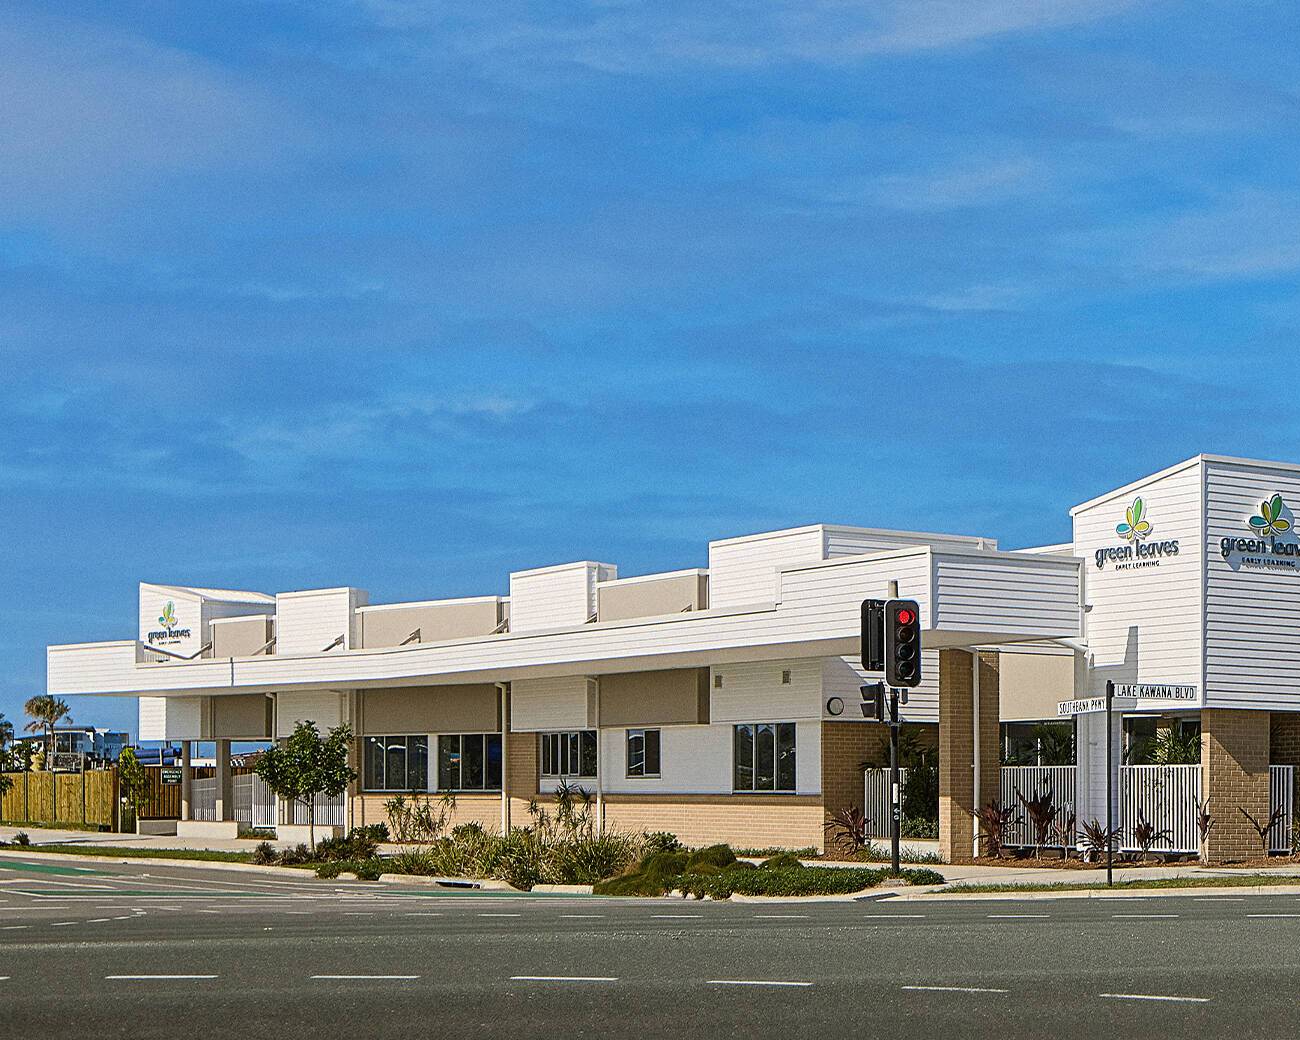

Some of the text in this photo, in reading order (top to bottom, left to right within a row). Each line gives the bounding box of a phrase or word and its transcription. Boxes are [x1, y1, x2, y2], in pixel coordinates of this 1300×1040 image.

[1095, 538, 1179, 569] green leaves
[1220, 537, 1266, 558] green
[1115, 560, 1160, 571] EARLY LEARNING
[1263, 559, 1296, 567] LEARNING
[148, 626, 191, 645] green leaves
[1117, 685, 1195, 699] LAKE KAWANA BLVD
